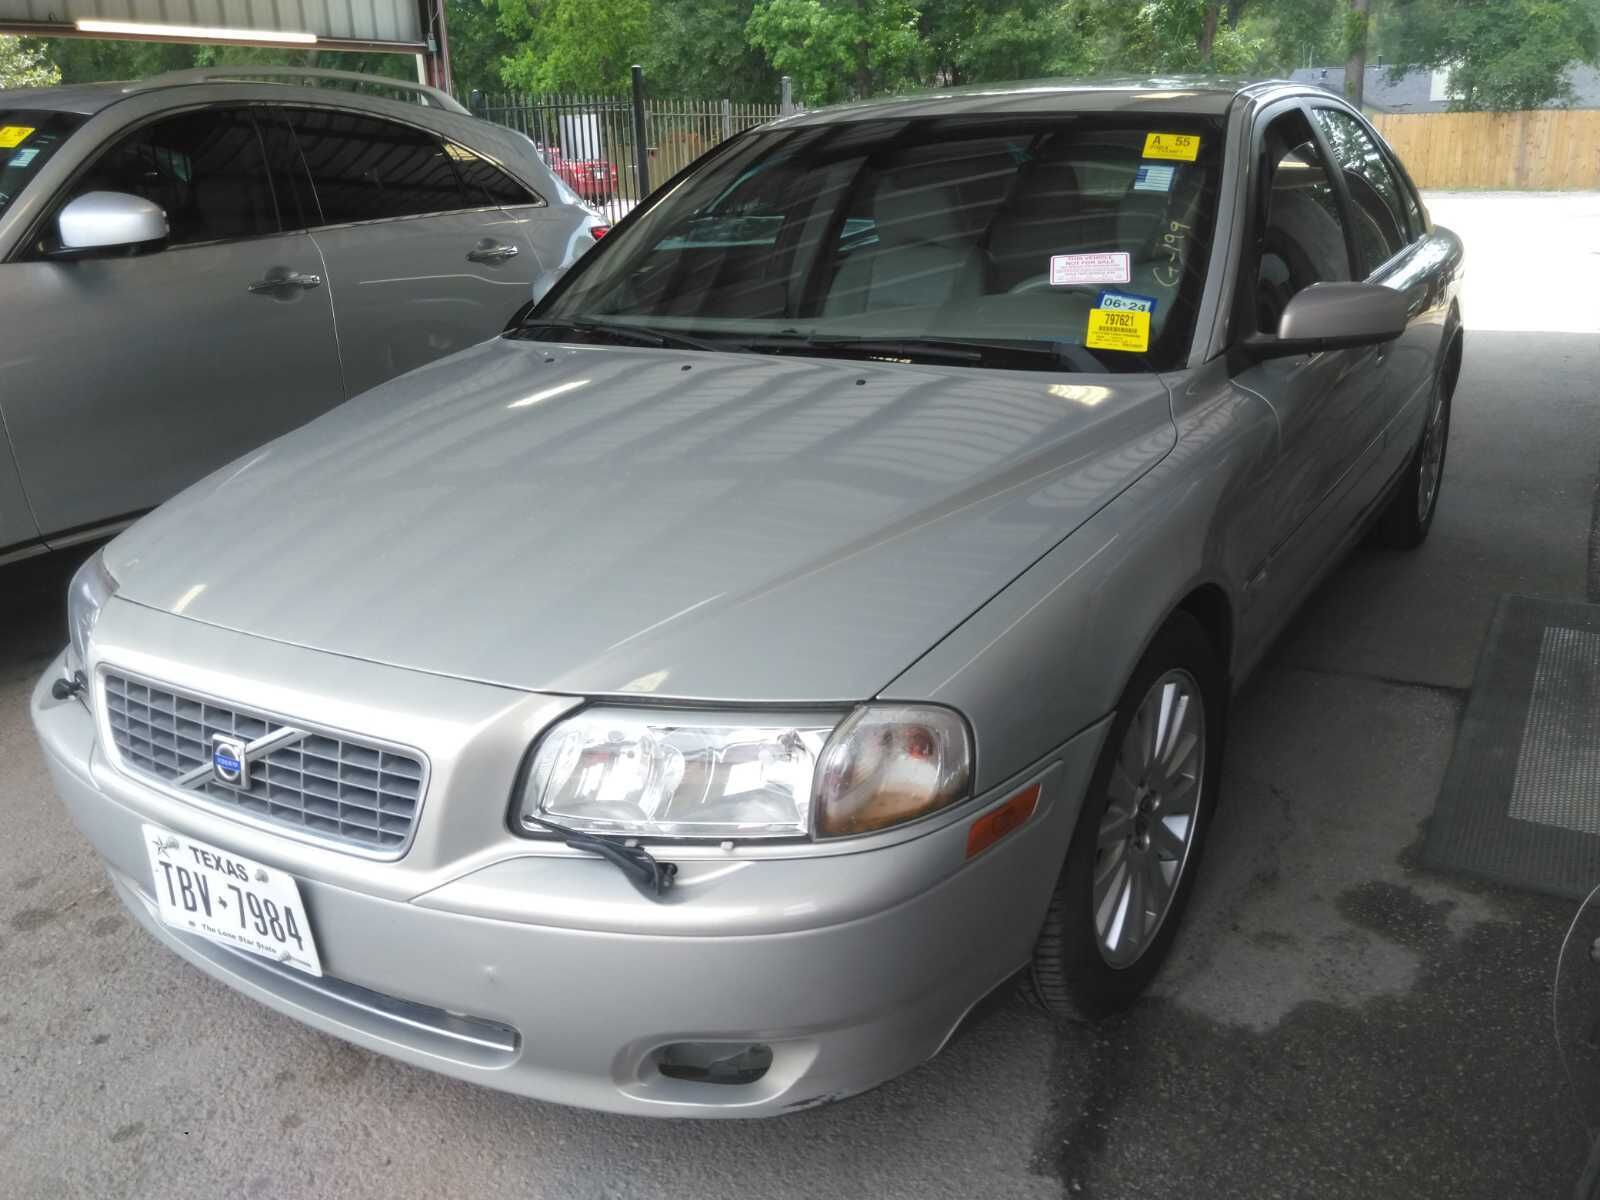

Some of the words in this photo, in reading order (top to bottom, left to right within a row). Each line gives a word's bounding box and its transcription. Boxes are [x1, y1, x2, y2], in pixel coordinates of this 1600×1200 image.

[1175, 136, 1191, 147] 55
[1104, 313, 1134, 327] 797621
[188, 845, 249, 882] TEXAS
[202, 923, 217, 934] The
[218, 928, 237, 940] Lone
[238, 934, 254, 946] Star
[255, 938, 278, 954] State
